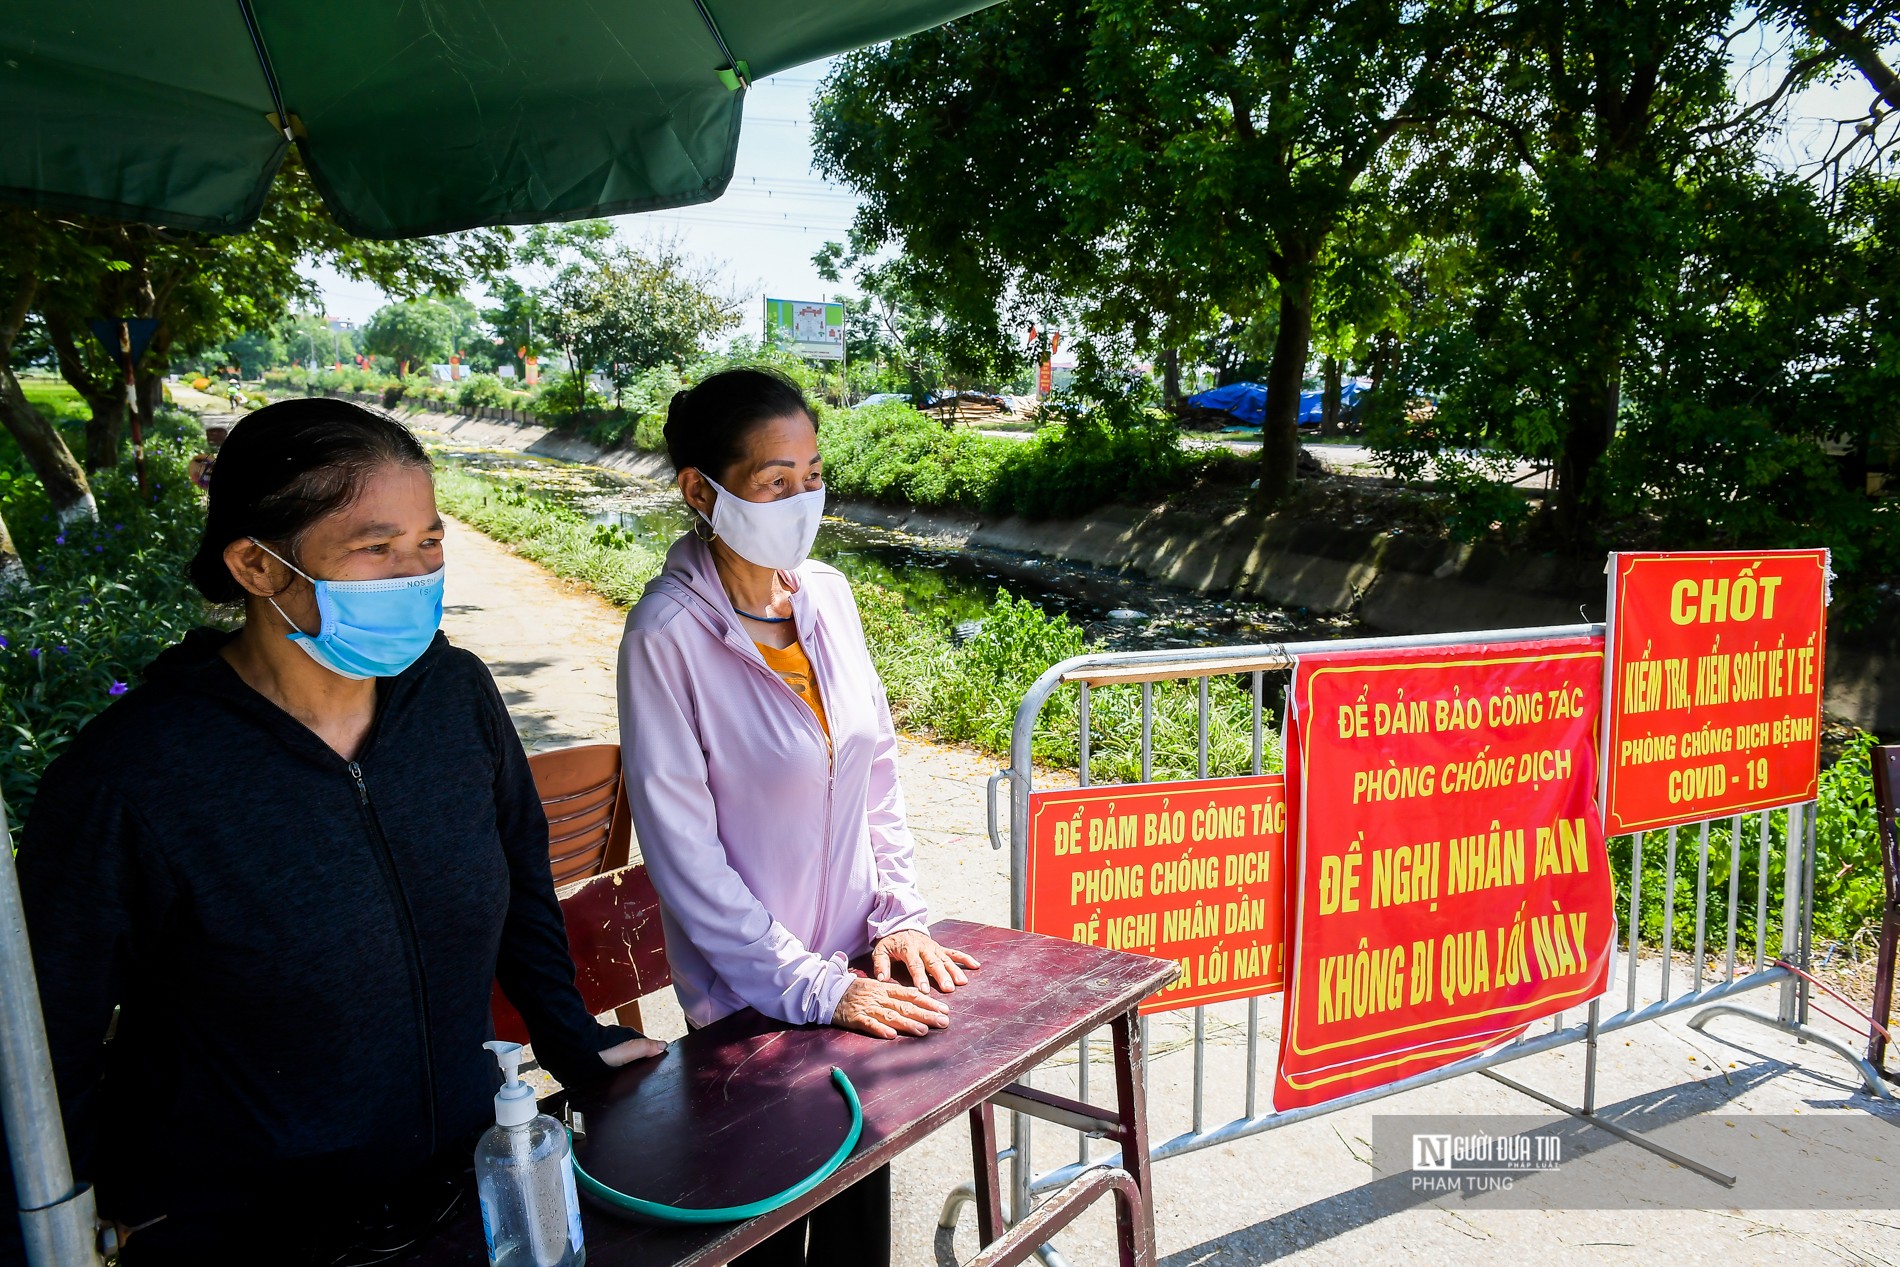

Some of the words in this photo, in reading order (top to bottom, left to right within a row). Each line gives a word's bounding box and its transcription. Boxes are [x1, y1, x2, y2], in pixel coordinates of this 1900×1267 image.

[1671, 562, 1782, 625] CHỐT
[1624, 639, 1662, 714] KIỂM
[1665, 658, 1691, 713] TRA,
[1695, 634, 1730, 706] KIỂM
[1733, 641, 1766, 702] SOÁT
[1769, 633, 1784, 697] VỀ
[1787, 649, 1795, 695] Y
[1798, 631, 1816, 694] TẾ
[1338, 684, 1369, 738] ĐỂ
[1374, 688, 1429, 735] ĐẢM
[1435, 685, 1482, 731] BẢO
[1489, 687, 1543, 727] CÔNG
[1548, 681, 1583, 719] TÁC
[1621, 732, 1676, 766] PHÒNG
[1681, 721, 1732, 758] CHỐNG
[1736, 723, 1769, 754] DỊCH
[1773, 715, 1812, 748] BỆNH
[1353, 760, 1435, 804] PHÒNG
[1441, 745, 1515, 793] CHỐNG
[1517, 750, 1571, 790] DỊCH
[1669, 764, 1726, 803] COVID
[1731, 775, 1740, 784] -
[1747, 758, 1767, 790] 19
[1054, 805, 1084, 856] ĐỂ
[1089, 802, 1137, 852] ĐẢM
[1144, 798, 1185, 846] BẢO
[1192, 801, 1245, 841] CÔNG
[1251, 796, 1286, 835] TÁC
[1071, 860, 1143, 906] PHÒNG
[1150, 847, 1219, 895] CHỐNG
[1225, 851, 1270, 892] DỊCH
[1319, 831, 1364, 915] ĐỀ
[1371, 842, 1440, 912] NGHỊ
[1448, 820, 1524, 895] NHÂN
[1072, 908, 1101, 945] ĐỀ
[1105, 913, 1157, 955] NGHỊ
[1163, 900, 1219, 943] NHÂN
[1225, 894, 1265, 934] DÂN
[1198, 940, 1228, 986] LỐI
[1234, 940, 1272, 980] NÀY
[1318, 937, 1405, 1025] KHÔNG
[1410, 939, 1434, 1005] ĐI
[1441, 930, 1489, 1005] QUA
[1495, 901, 1531, 988] LỐI
[1532, 901, 1587, 980] NÀY
